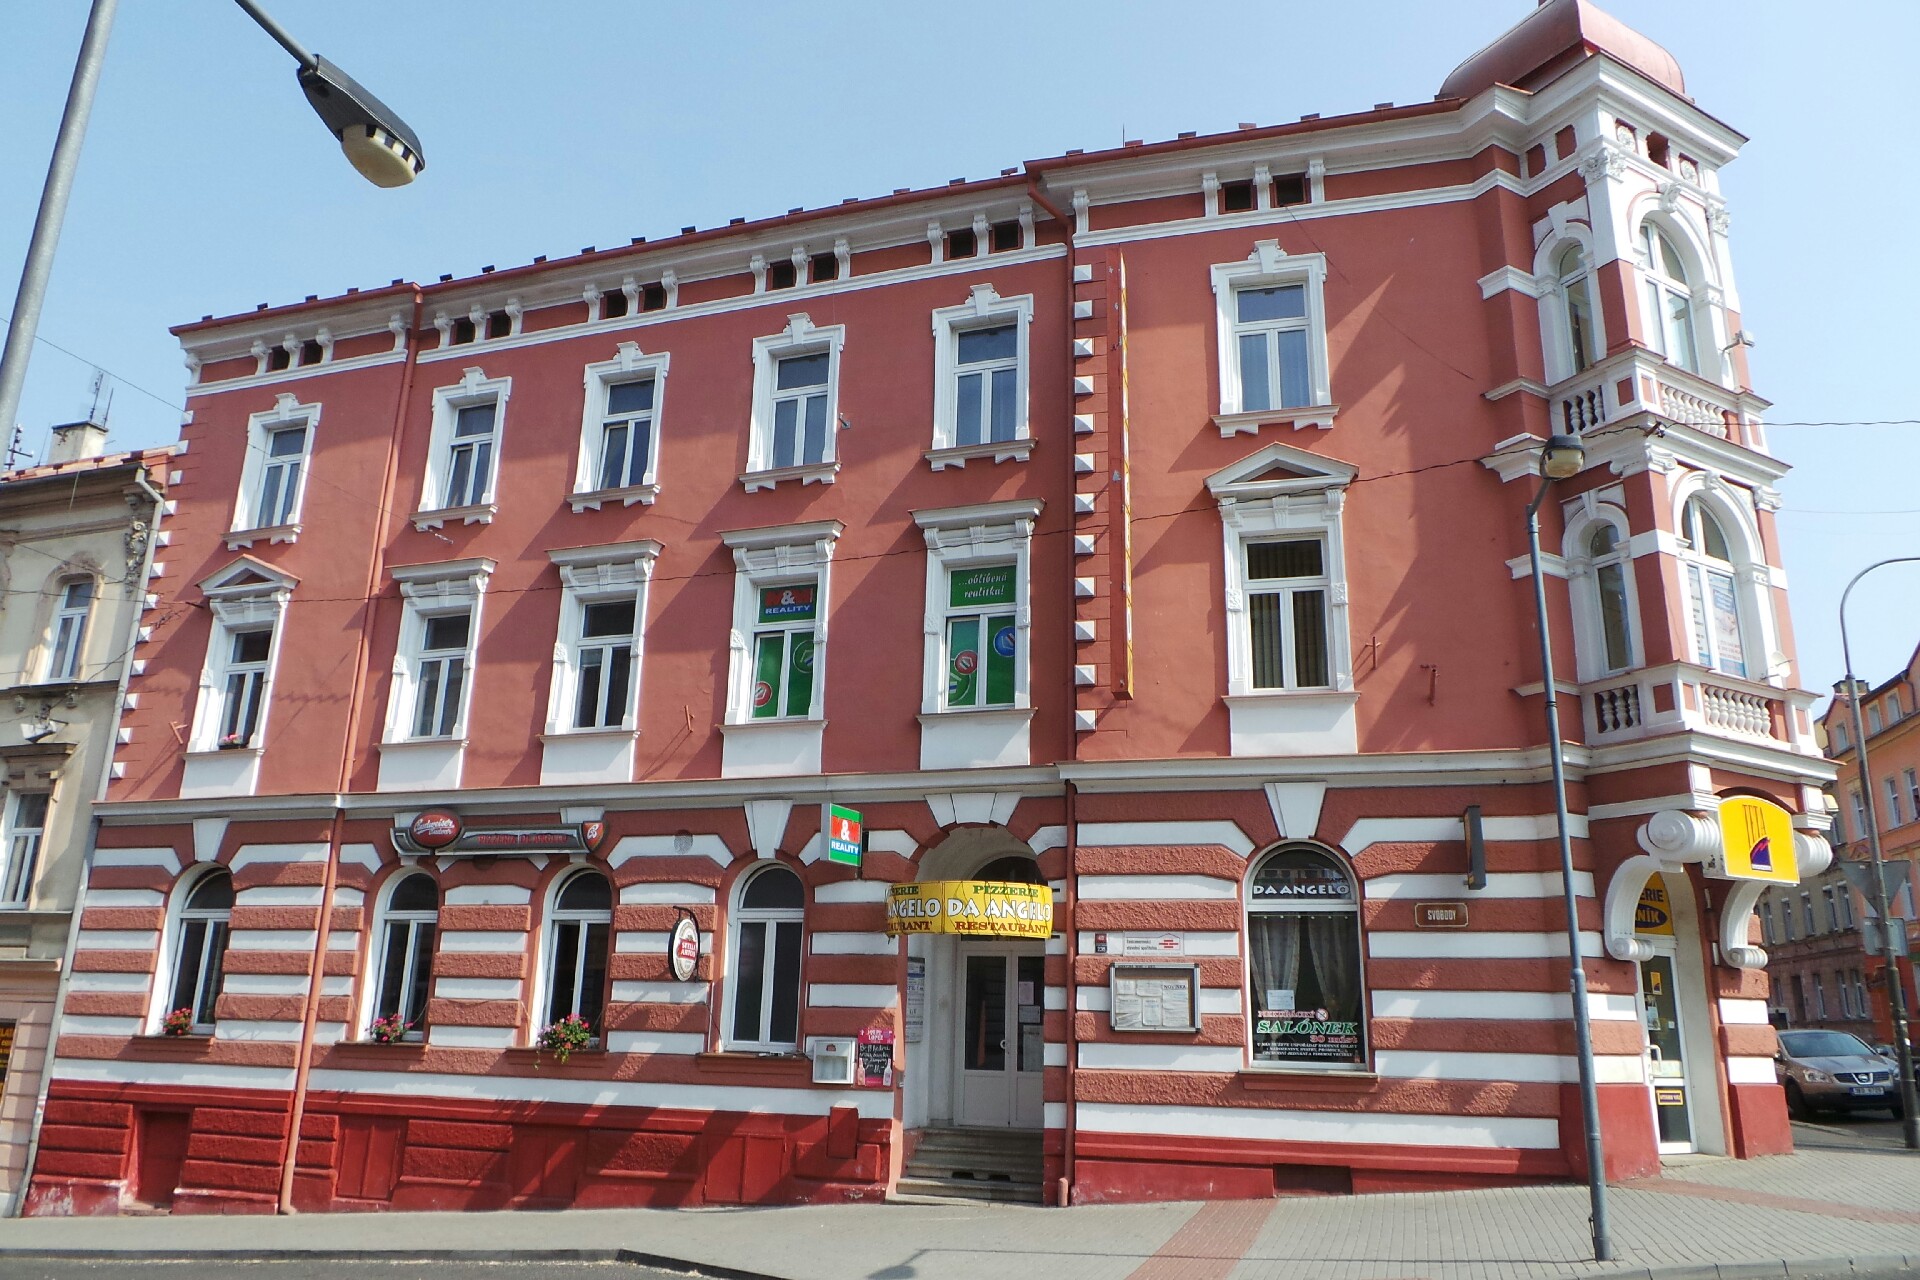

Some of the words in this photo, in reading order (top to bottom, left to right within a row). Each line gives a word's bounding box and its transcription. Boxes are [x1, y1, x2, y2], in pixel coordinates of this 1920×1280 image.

[964, 585, 1005, 598] realitka!
[765, 605, 810, 614] REALITY
[831, 840, 859, 854] REALITY
[973, 884, 1039, 898] PIZZERIE
[1253, 885, 1278, 895] DA
[1279, 885, 1351, 895] ANGELO
[947, 898, 981, 918] DA
[984, 899, 1051, 922] ANGELO
[1427, 909, 1457, 921] SVOBODY
[954, 920, 1048, 935] RESTAURANT
[1257, 1018, 1358, 1035] SALÓNEK
